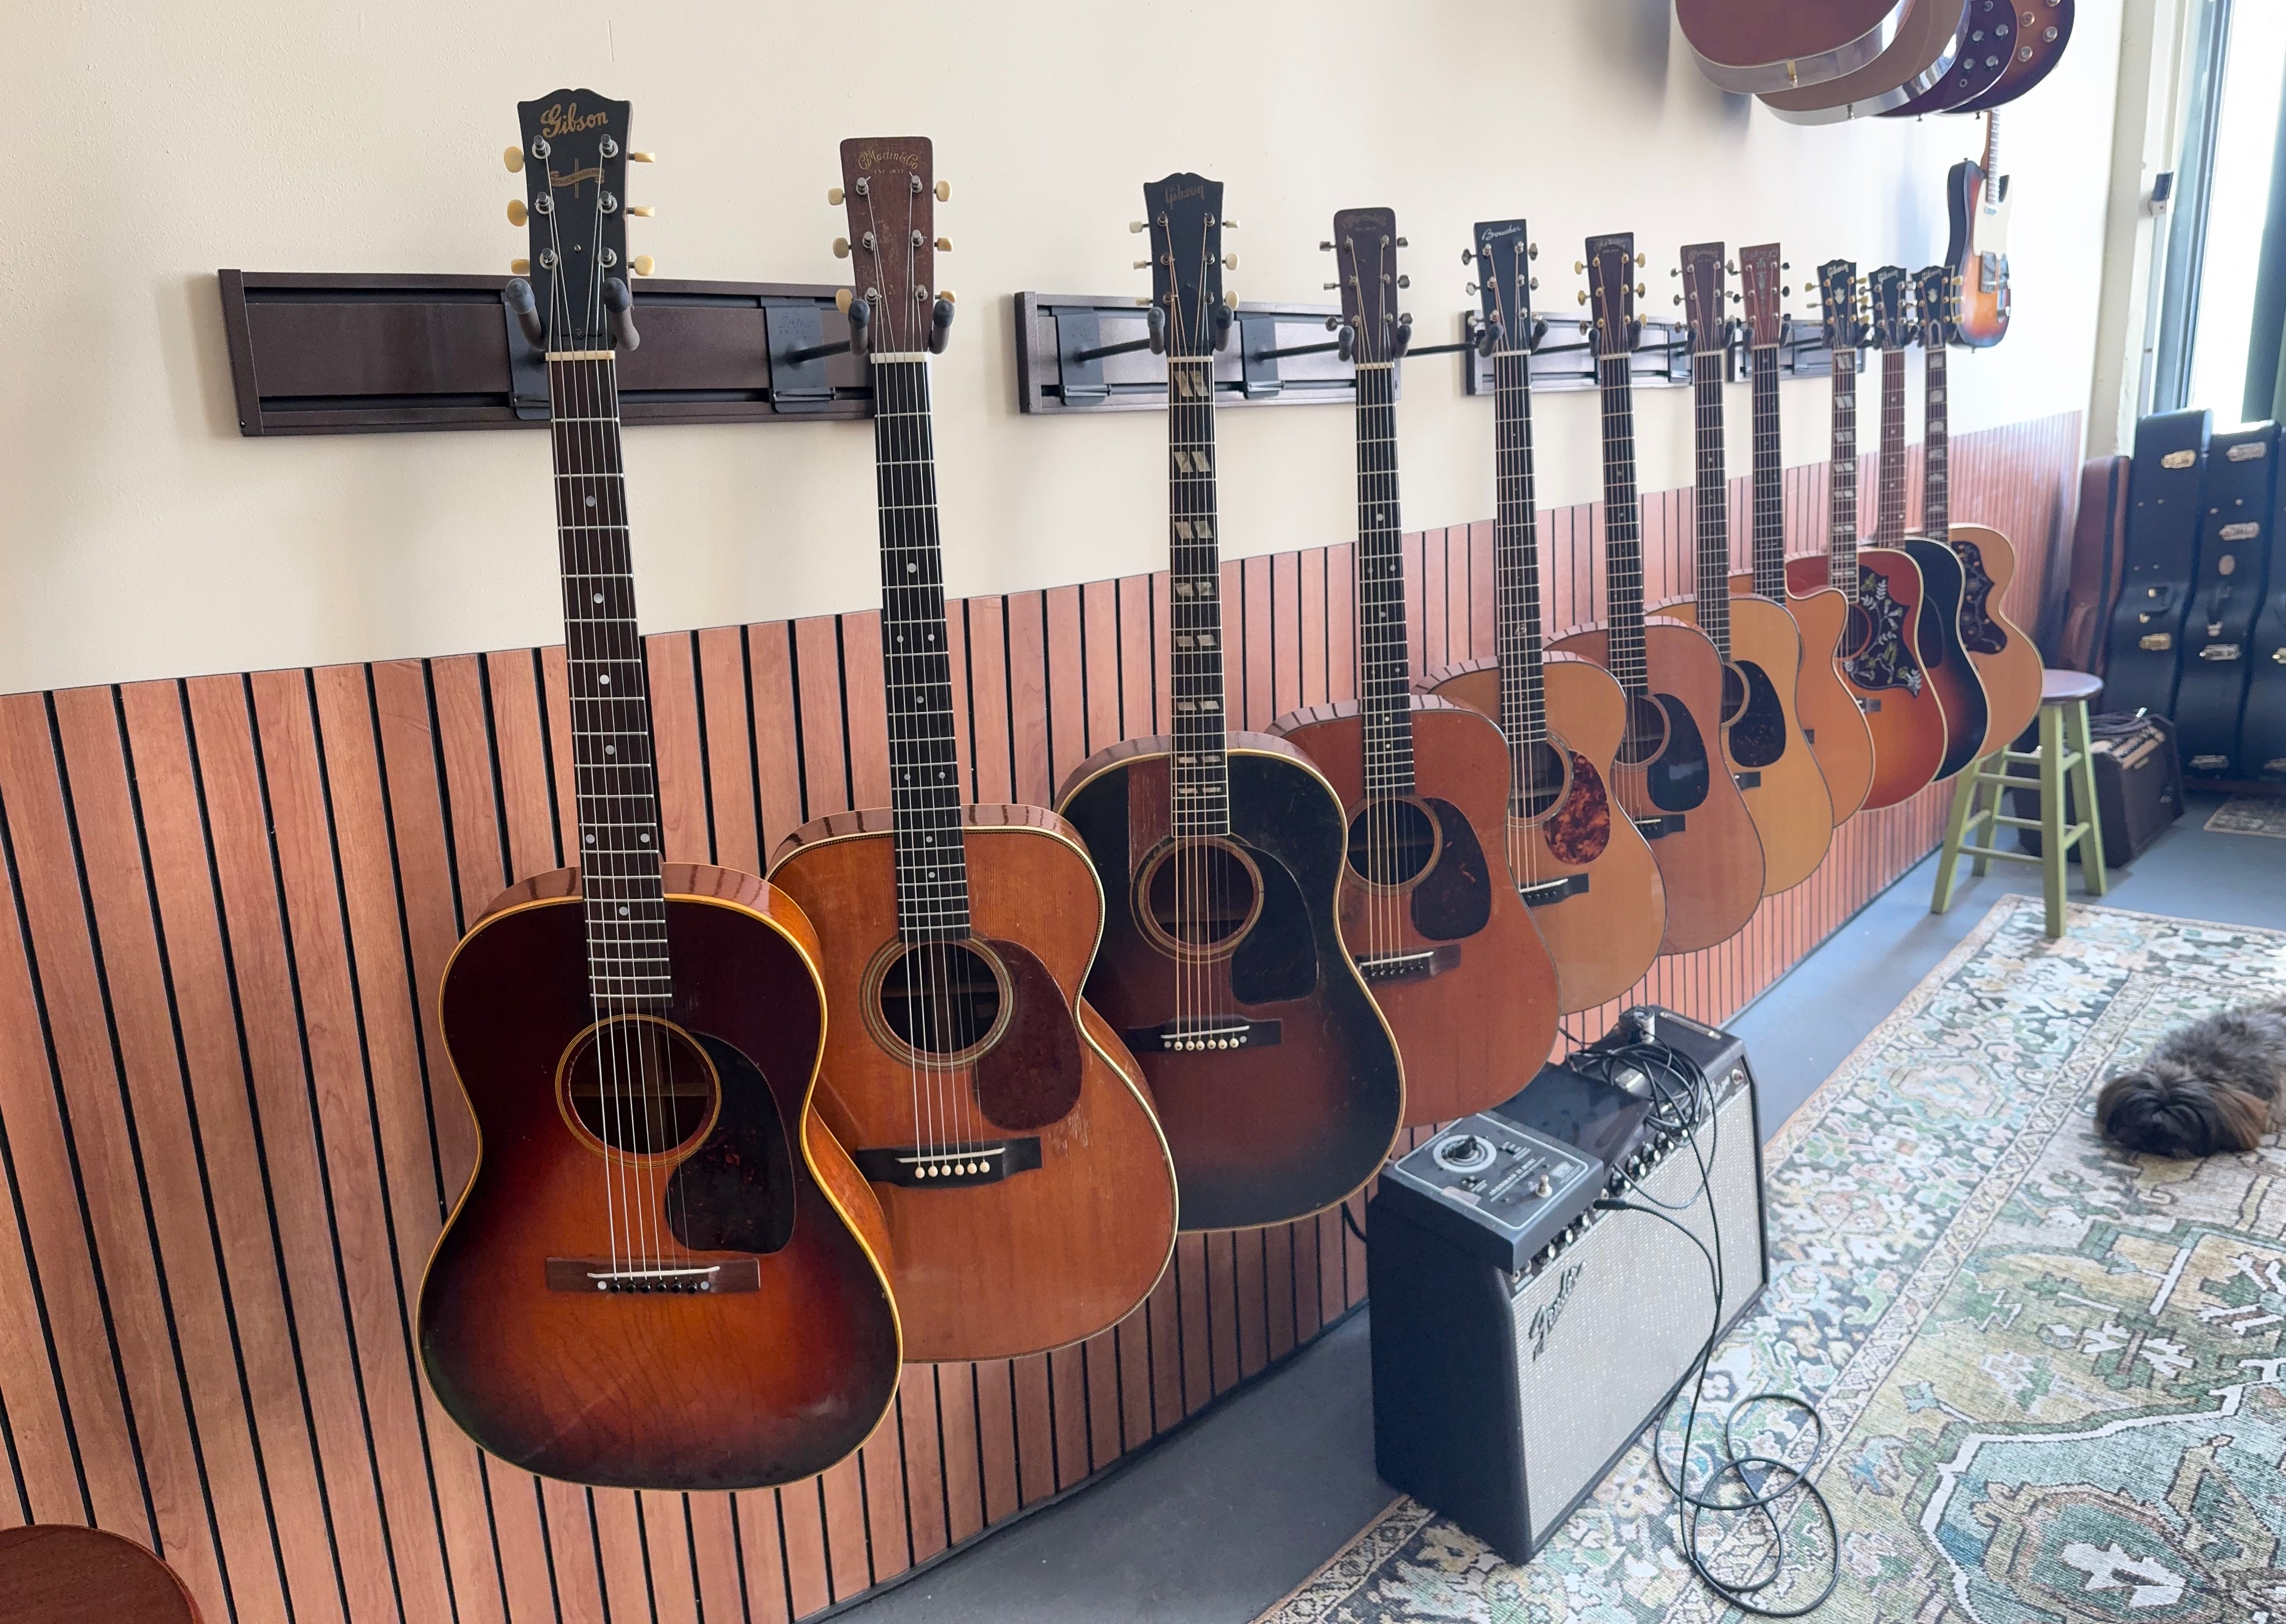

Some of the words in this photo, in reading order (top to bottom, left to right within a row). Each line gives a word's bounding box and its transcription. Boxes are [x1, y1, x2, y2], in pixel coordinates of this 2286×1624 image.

[540, 102, 608, 138] Gibson
[1165, 185, 1205, 210] Gibson
[1482, 224, 1522, 241] Boucher
